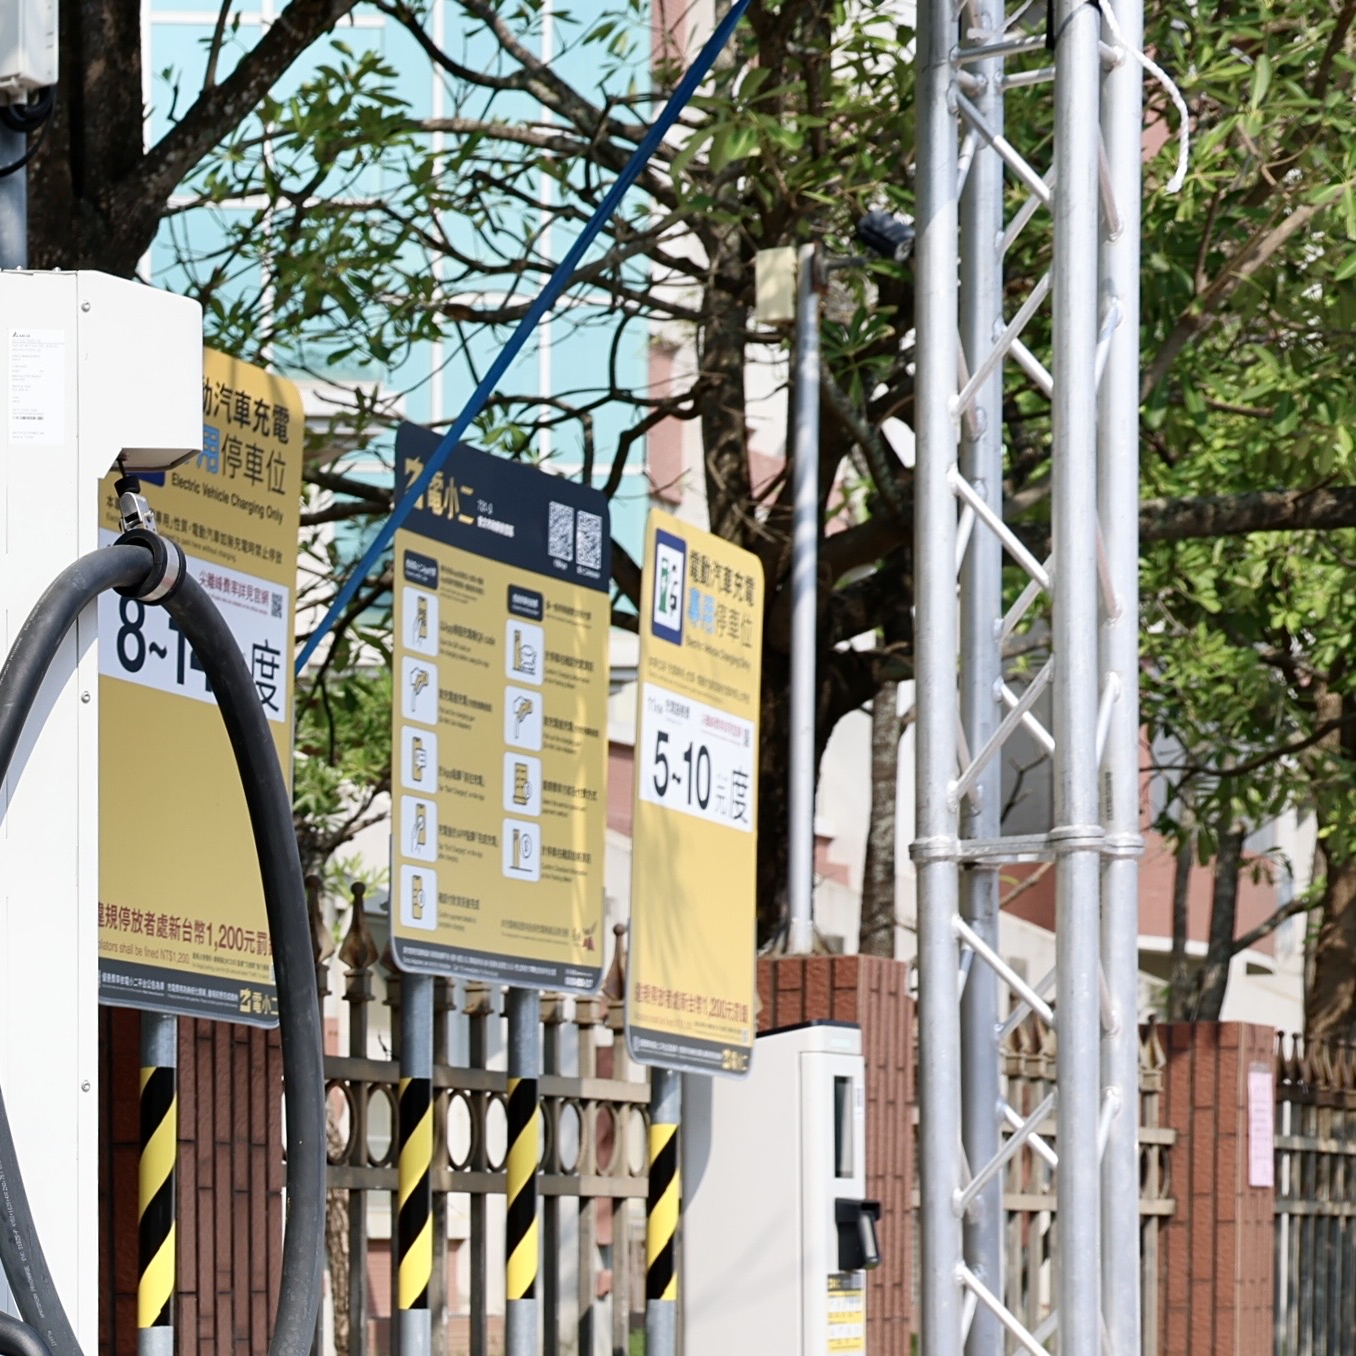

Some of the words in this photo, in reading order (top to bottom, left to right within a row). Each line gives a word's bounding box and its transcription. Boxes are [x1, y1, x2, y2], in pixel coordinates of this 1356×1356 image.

[172, 472, 200, 494] Electric
[202, 484, 229, 502] Vehicle
[231, 493, 264, 518] Charging
[266, 505, 284, 526] Only
[251, 638, 282, 712] 度
